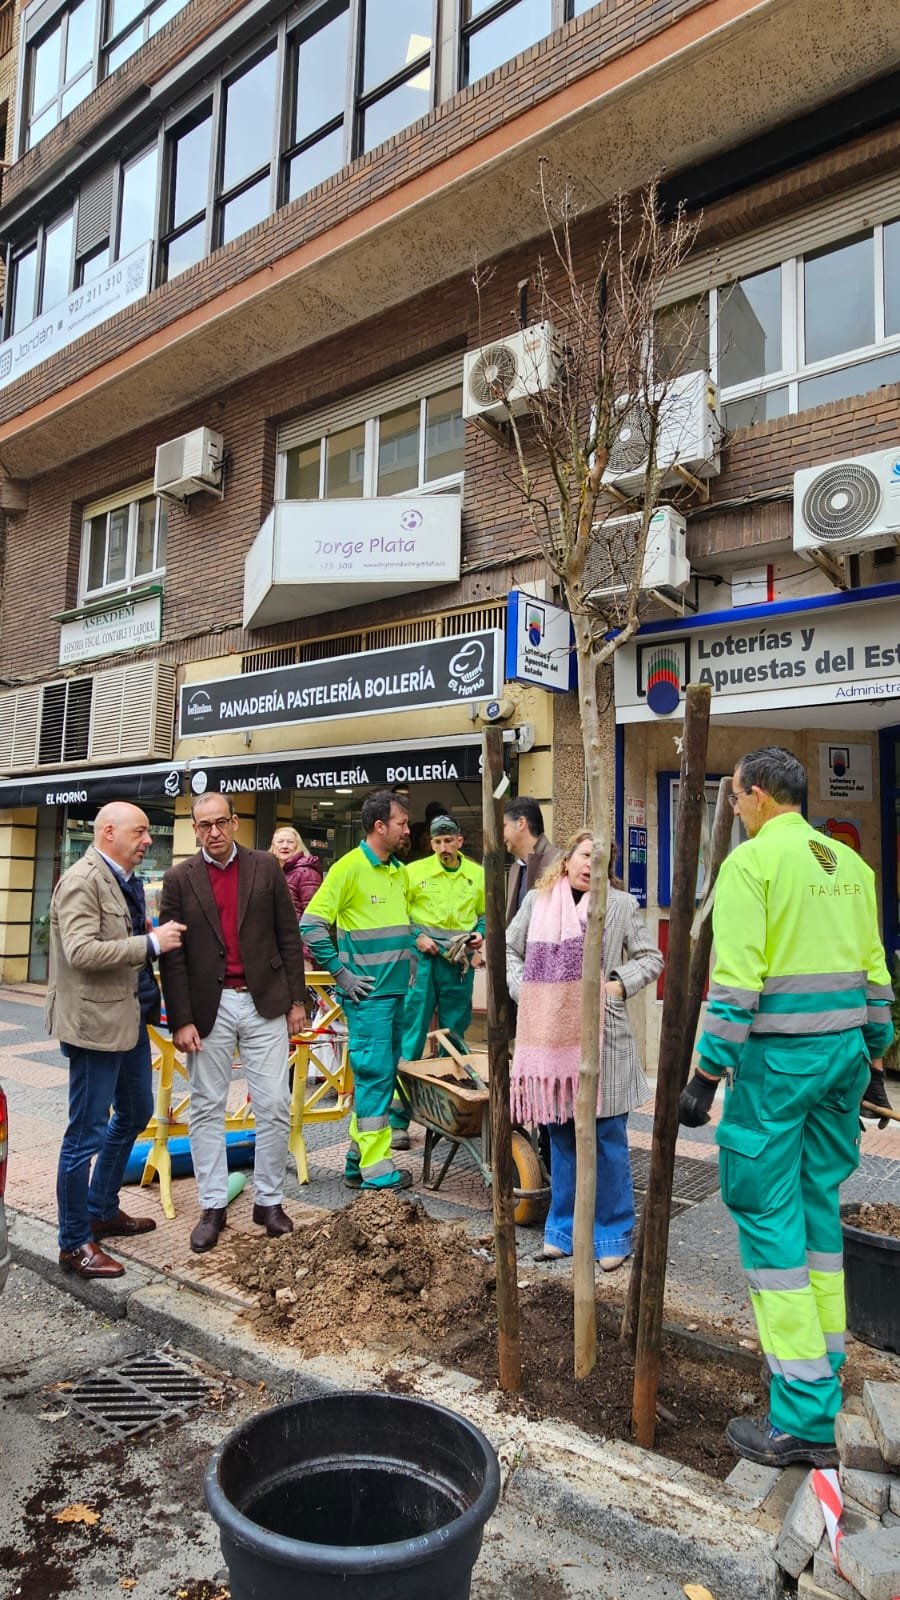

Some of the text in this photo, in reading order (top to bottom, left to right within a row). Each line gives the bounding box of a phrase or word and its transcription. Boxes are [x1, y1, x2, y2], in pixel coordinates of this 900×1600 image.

[68, 295, 85, 315] 927
[87, 284, 102, 304] 211
[105, 269, 123, 291] 310
[314, 536, 417, 558] Jorge Plata
[698, 628, 815, 659] Loterías y
[700, 658, 806, 692] Apuestas
[815, 648, 854, 674] del
[219, 665, 435, 719] PANADERÍA PASTELERÍA BOLLERÍA
[220, 760, 458, 792] PANADERÍA PASTELERÍA BOLLERÍA
[46, 790, 87, 805] EL HORNO
